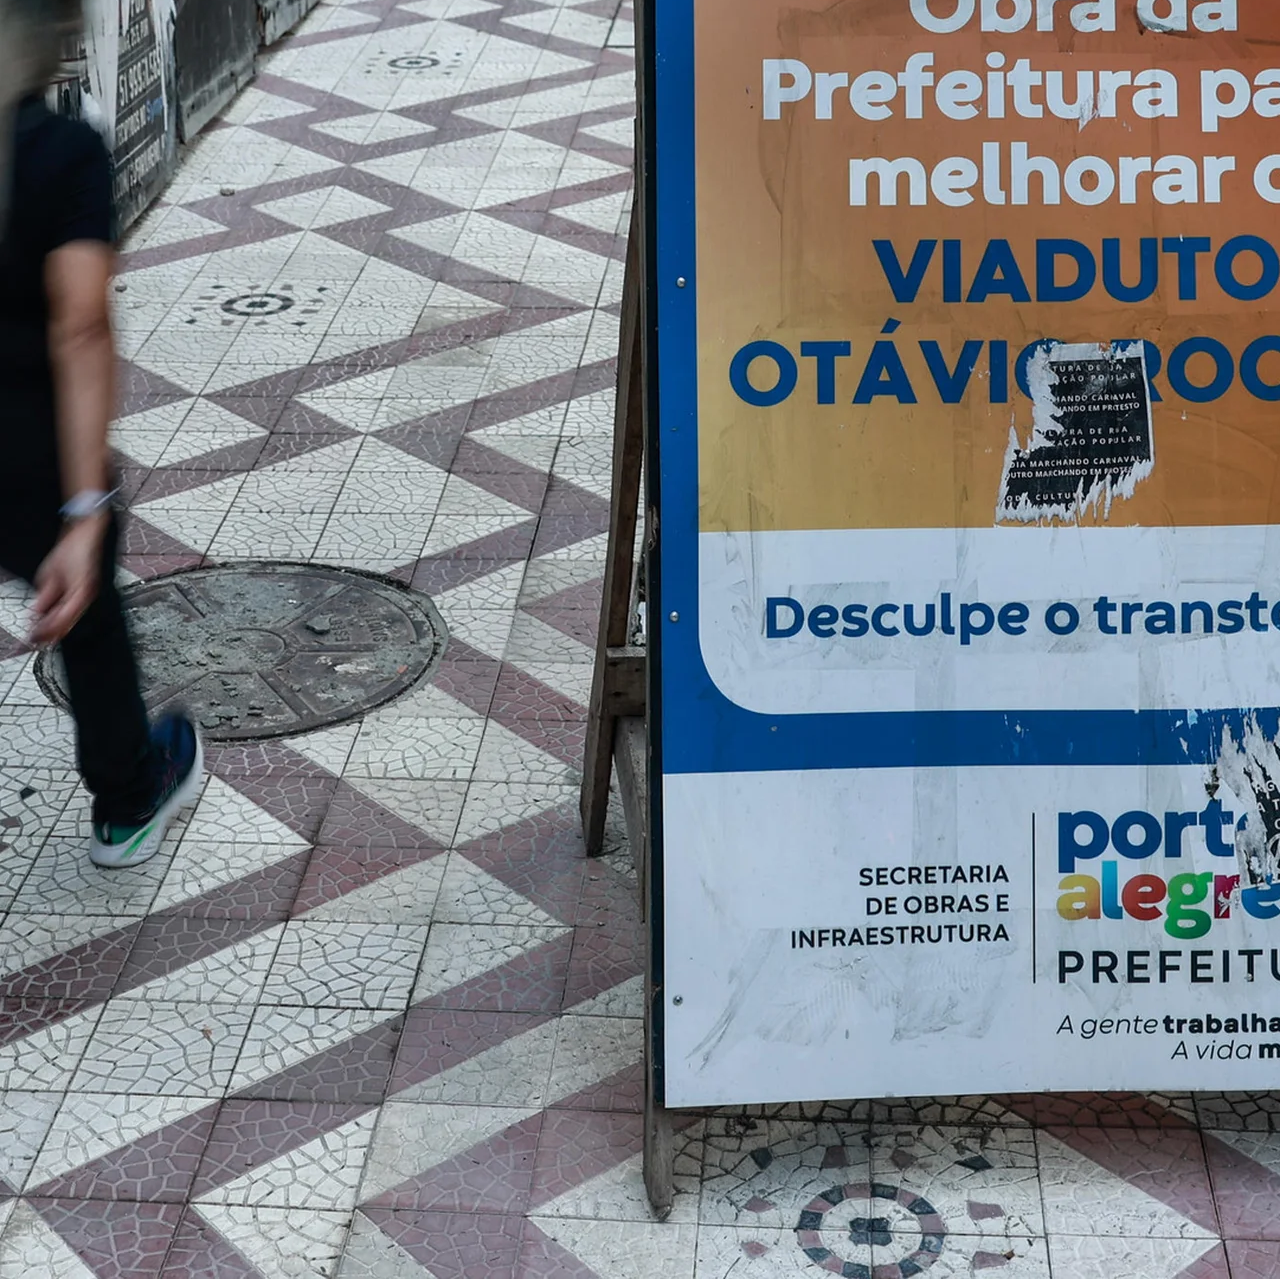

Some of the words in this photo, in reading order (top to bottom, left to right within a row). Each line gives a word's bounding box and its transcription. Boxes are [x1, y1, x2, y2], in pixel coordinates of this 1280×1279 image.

[762, 51, 1179, 121] Prefeitura
[848, 141, 1236, 208] melhorar
[1088, 404, 1100, 412] EM
[1089, 427, 1102, 435] DE
[1092, 435, 1142, 445] POPULAR
[1029, 458, 1090, 468] MARCHANDO
[1093, 455, 1141, 465] CARNAVAL
[1035, 468, 1088, 478] MARCHANDO
[763, 592, 1028, 647] Desculpe
[1044, 601, 1081, 637] o
[1058, 800, 1251, 859] port
[858, 865, 1010, 886] SECRETARIA
[866, 895, 899, 916] DE
[902, 893, 990, 916] OBRAS
[997, 893, 1010, 913] E
[790, 924, 1010, 950] INFRAESTRUTURA
[1056, 1015, 1075, 1036] A
[1079, 1016, 1158, 1039] gente
[1170, 1039, 1190, 1061] A
[1192, 1036, 1253, 1061] vida
